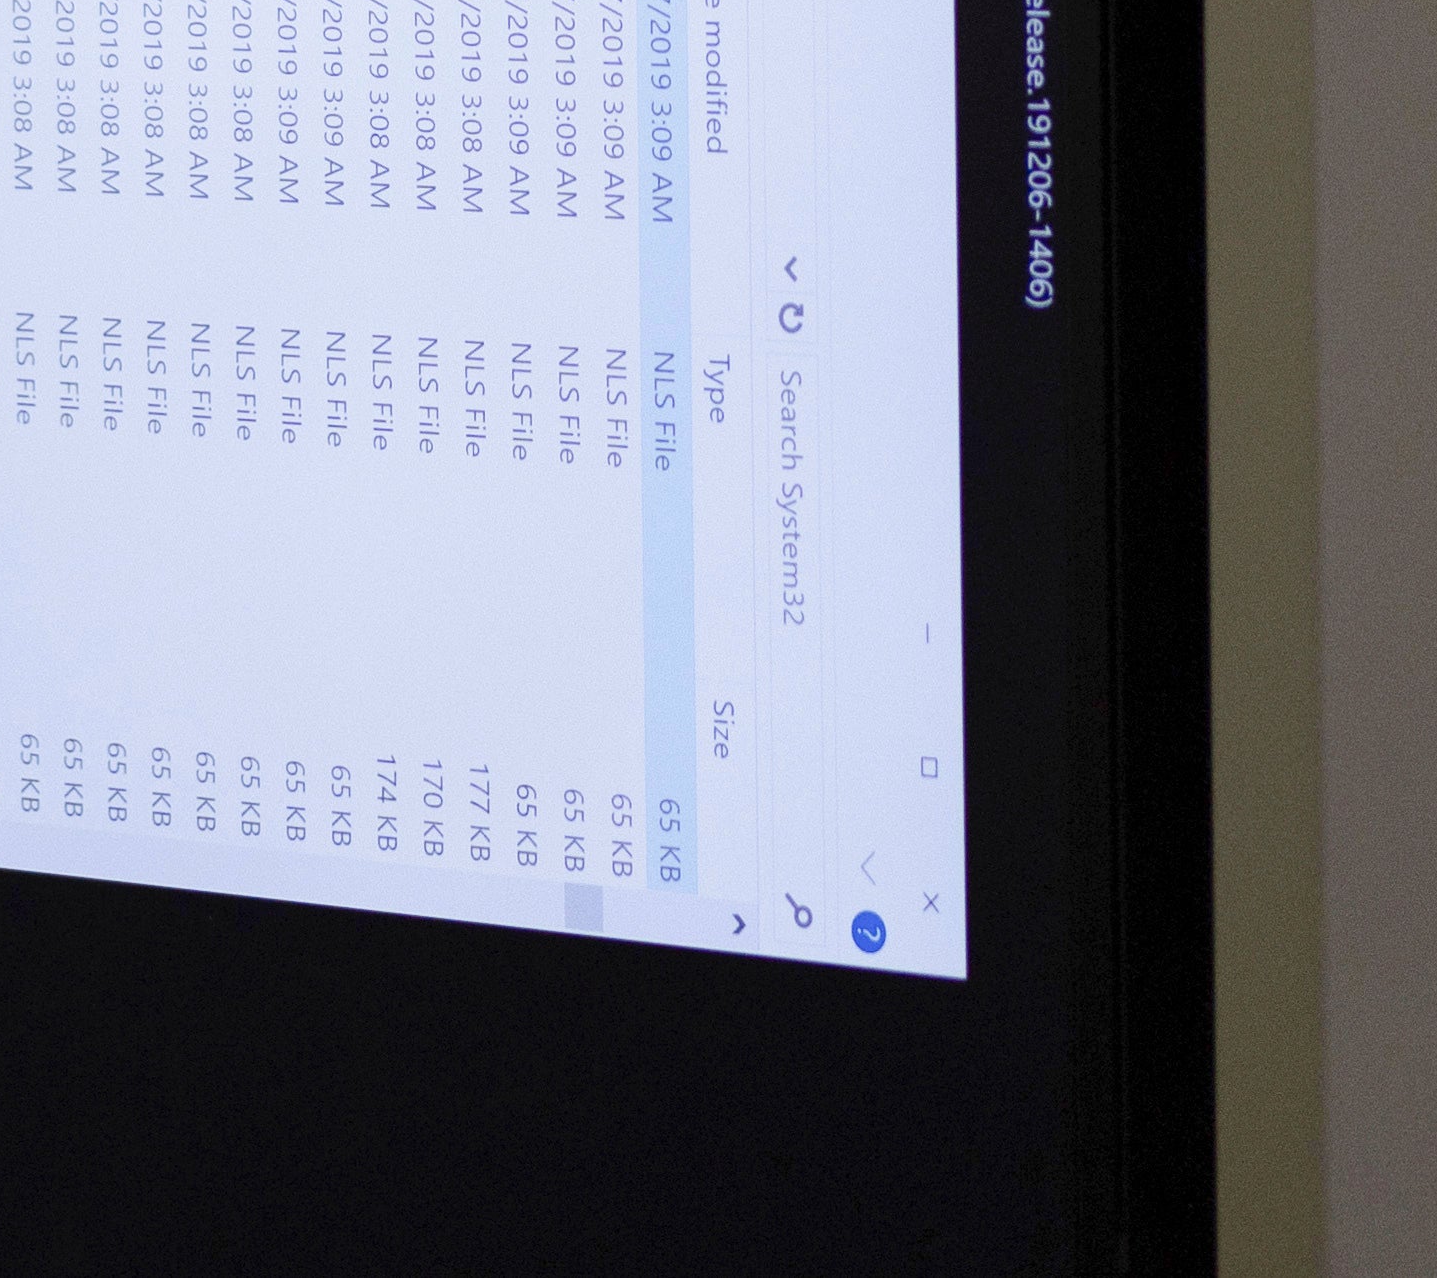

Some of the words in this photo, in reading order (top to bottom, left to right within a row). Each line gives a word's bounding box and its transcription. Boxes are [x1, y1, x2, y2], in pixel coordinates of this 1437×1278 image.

[99, 79, 121, 138] 3:08
[704, 20, 729, 155] modified
[368, 90, 391, 150] 3:08
[414, 91, 437, 152] 3:08
[460, 93, 484, 154] 3:08
[650, 100, 674, 163] 3:09
[100, 146, 121, 196] AM
[369, 158, 392, 209] AM
[415, 160, 438, 212] AM
[461, 162, 484, 214] AM
[651, 171, 674, 224] AM
[101, 316, 124, 373] NLS
[371, 333, 394, 391] NLS
[417, 336, 440, 394] NLS
[463, 339, 487, 397] NLS
[653, 350, 677, 410] NLS
[702, 353, 732, 425] Type
[102, 383, 124, 432] File
[372, 401, 395, 452] File
[418, 404, 441, 455] File
[464, 407, 488, 459] File
[779, 369, 804, 472] Search
[654, 420, 677, 472] File
[775, 482, 806, 627] System32
[712, 699, 736, 760] Size
[106, 741, 128, 776] 65
[375, 754, 398, 804] 174
[422, 758, 445, 810] 170
[106, 786, 129, 823] KB
[468, 763, 492, 816] 177
[658, 797, 682, 834] 65
[376, 814, 399, 853] KB
[422, 819, 445, 858] KB
[469, 824, 492, 863] KB
[658, 844, 683, 884] KB
